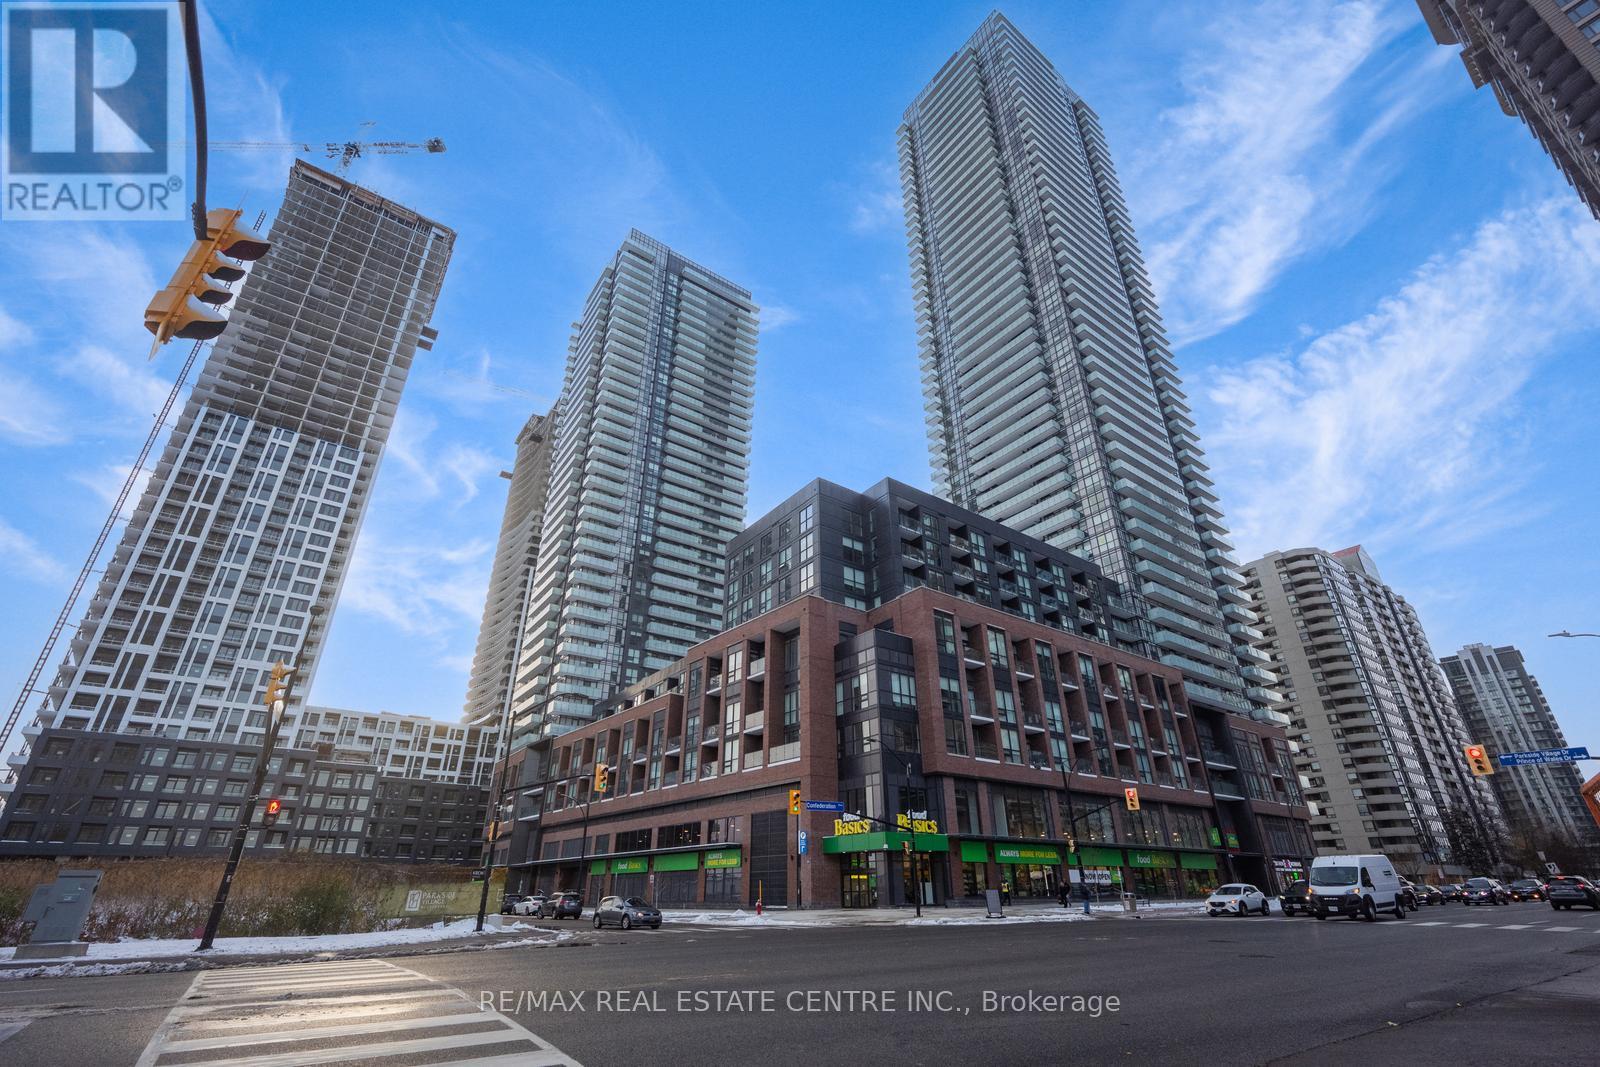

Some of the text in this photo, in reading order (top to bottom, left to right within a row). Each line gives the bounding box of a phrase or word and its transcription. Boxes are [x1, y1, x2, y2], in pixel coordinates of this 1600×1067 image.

[834, 818, 870, 836] Basics
[1137, 854, 1151, 864] food
[1098, 873, 1111, 881] OPEN
